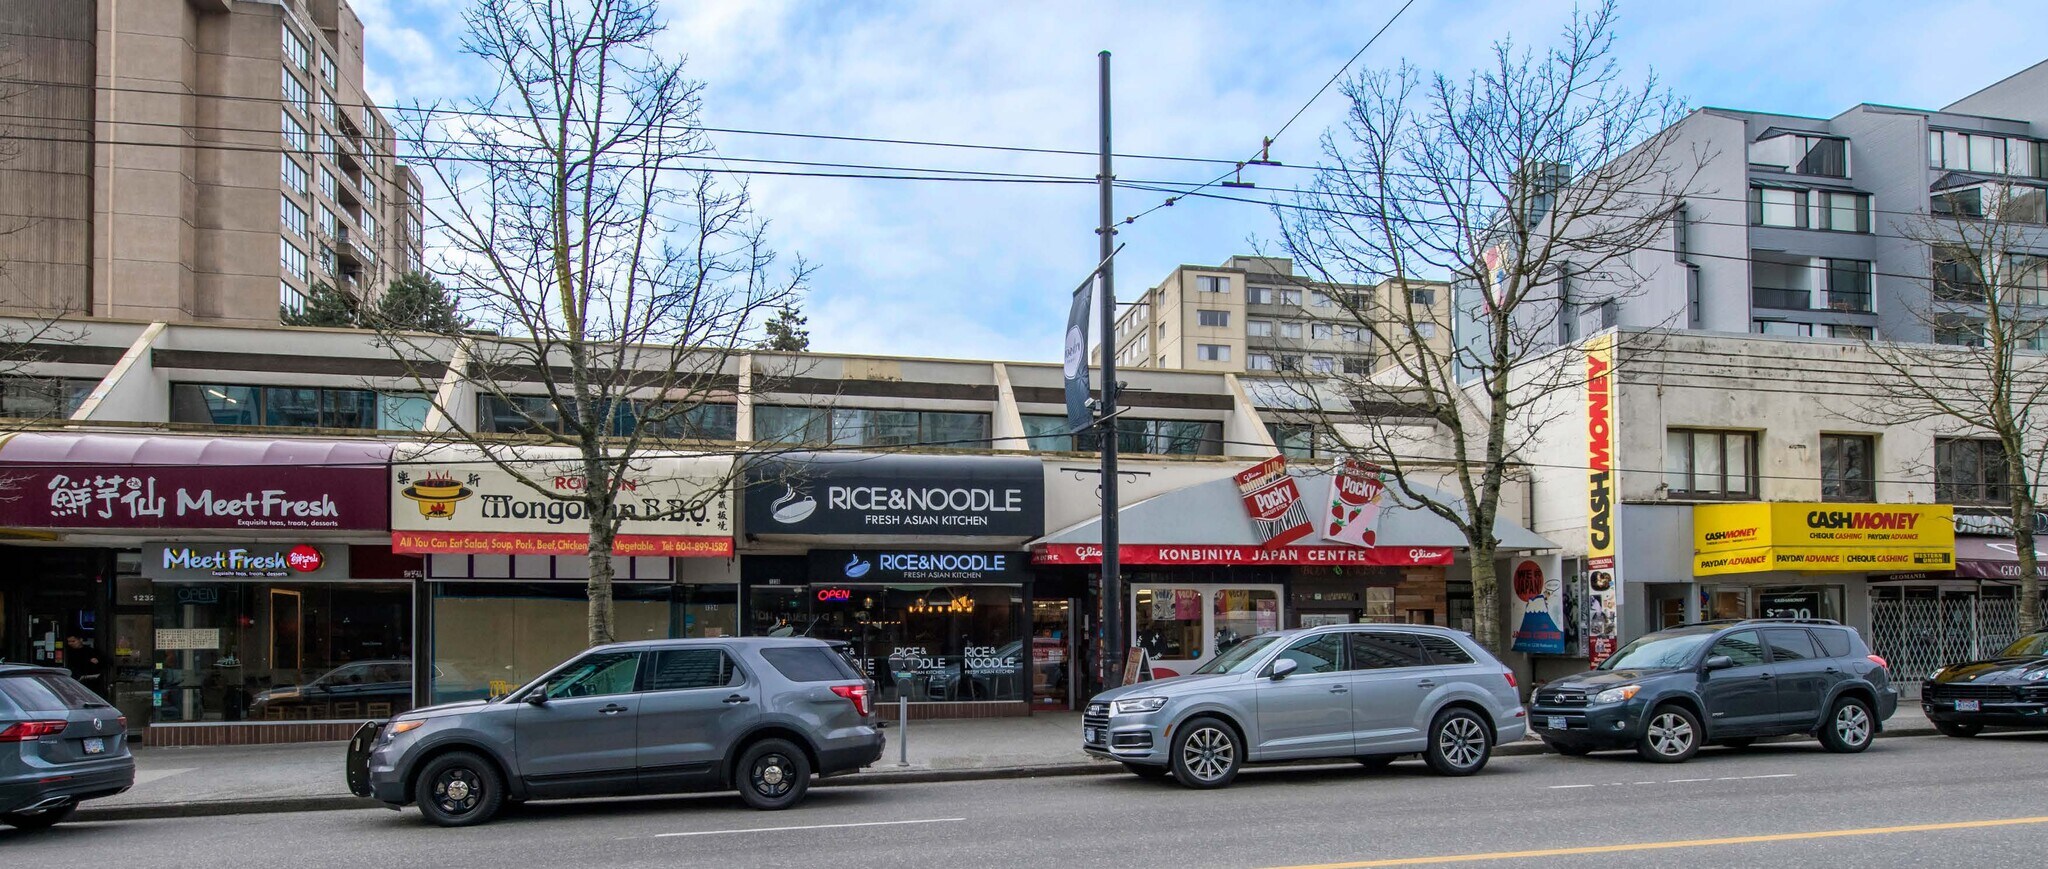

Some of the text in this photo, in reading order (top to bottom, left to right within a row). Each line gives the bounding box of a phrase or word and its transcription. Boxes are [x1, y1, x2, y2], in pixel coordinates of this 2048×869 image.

[1588, 355, 1610, 550] CASHMONEY
[555, 475, 637, 492] ROON
[47, 474, 167, 518] 鮮芋仙
[176, 487, 339, 517] Meet Fresh
[828, 486, 1022, 512] RICE&NOODLE
[480, 494, 636, 525] Mongoln
[237, 518, 339, 527] Exquisite teas, treats, desserts
[865, 514, 988, 526] FRESH ASIAN KITCHEN
[1807, 510, 1919, 530] CASHMONEY
[1704, 528, 1758, 541] CASHMONEY
[1809, 532, 1834, 540] CHEQUE
[400, 537, 412, 548] All
[414, 537, 429, 548] You
[431, 538, 448, 548] Can
[449, 538, 463, 549] Eat
[464, 538, 489, 550] Salad,
[491, 539, 513, 551] Soup,
[515, 539, 535, 551] Pork,
[614, 541, 656, 552] Vegetable.
[662, 541, 674, 551] Tel:
[675, 541, 729, 552] 604-899-1582
[163, 547, 287, 569] Meet Fresh
[1159, 549, 1365, 561] KONBINIYA JAPAN CENTRE
[1409, 549, 1442, 563] Glico
[1776, 554, 1909, 563] PAYDAY ADVANCE CHEQUE CASHING
[880, 554, 1005, 571] RICE&NOODLE
[1701, 555, 1767, 569] PAYDAY ADVANCE
[952, 571, 982, 579] KITCHEN
[2000, 565, 2048, 577] GEONI
[178, 587, 218, 600] OPEN
[818, 589, 851, 601] OPEN
[921, 647, 927, 655] &
[964, 647, 996, 658] RICE &
[964, 658, 1015, 669] NOODLE
